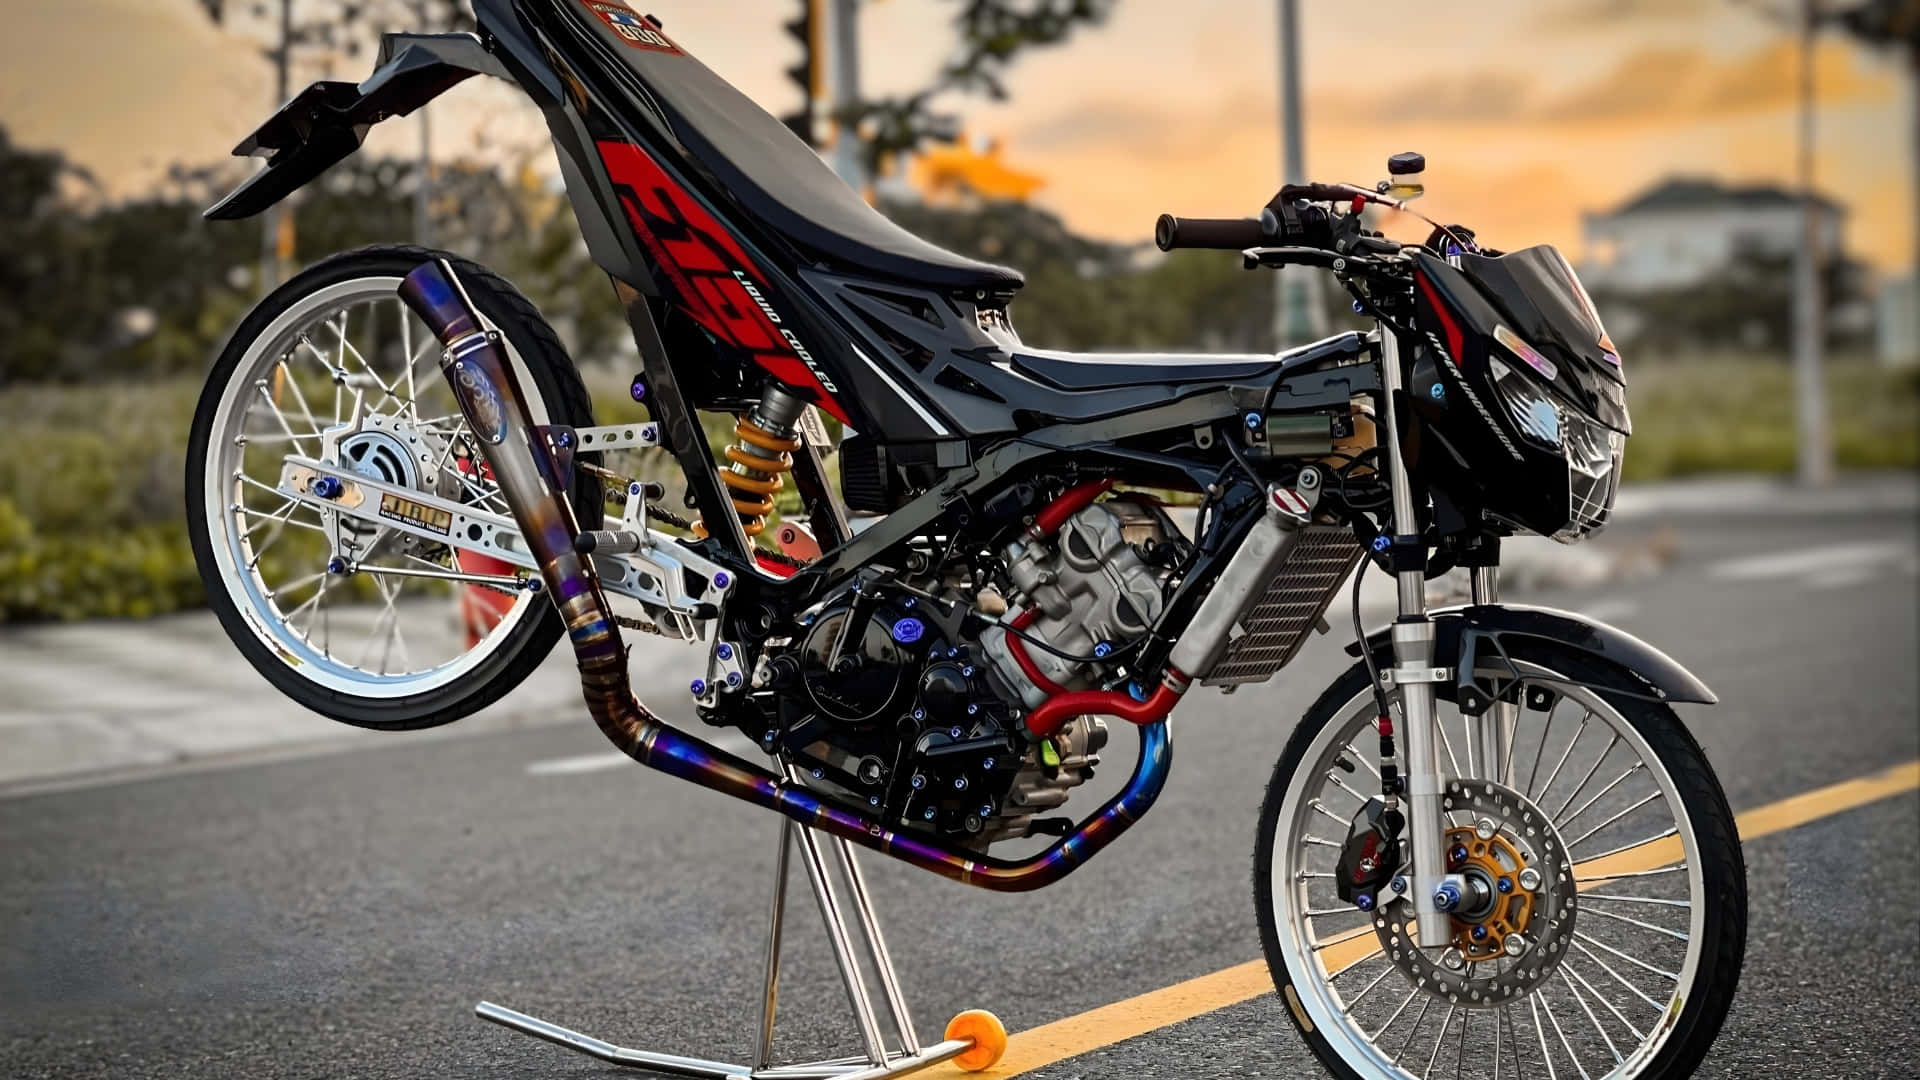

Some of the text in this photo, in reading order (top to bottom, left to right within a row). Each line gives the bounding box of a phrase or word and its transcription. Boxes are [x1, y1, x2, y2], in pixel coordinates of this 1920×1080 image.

[732, 270, 781, 323] LIQUID
[780, 328, 838, 393] COOLED
[1426, 331, 1463, 379] HYPER
